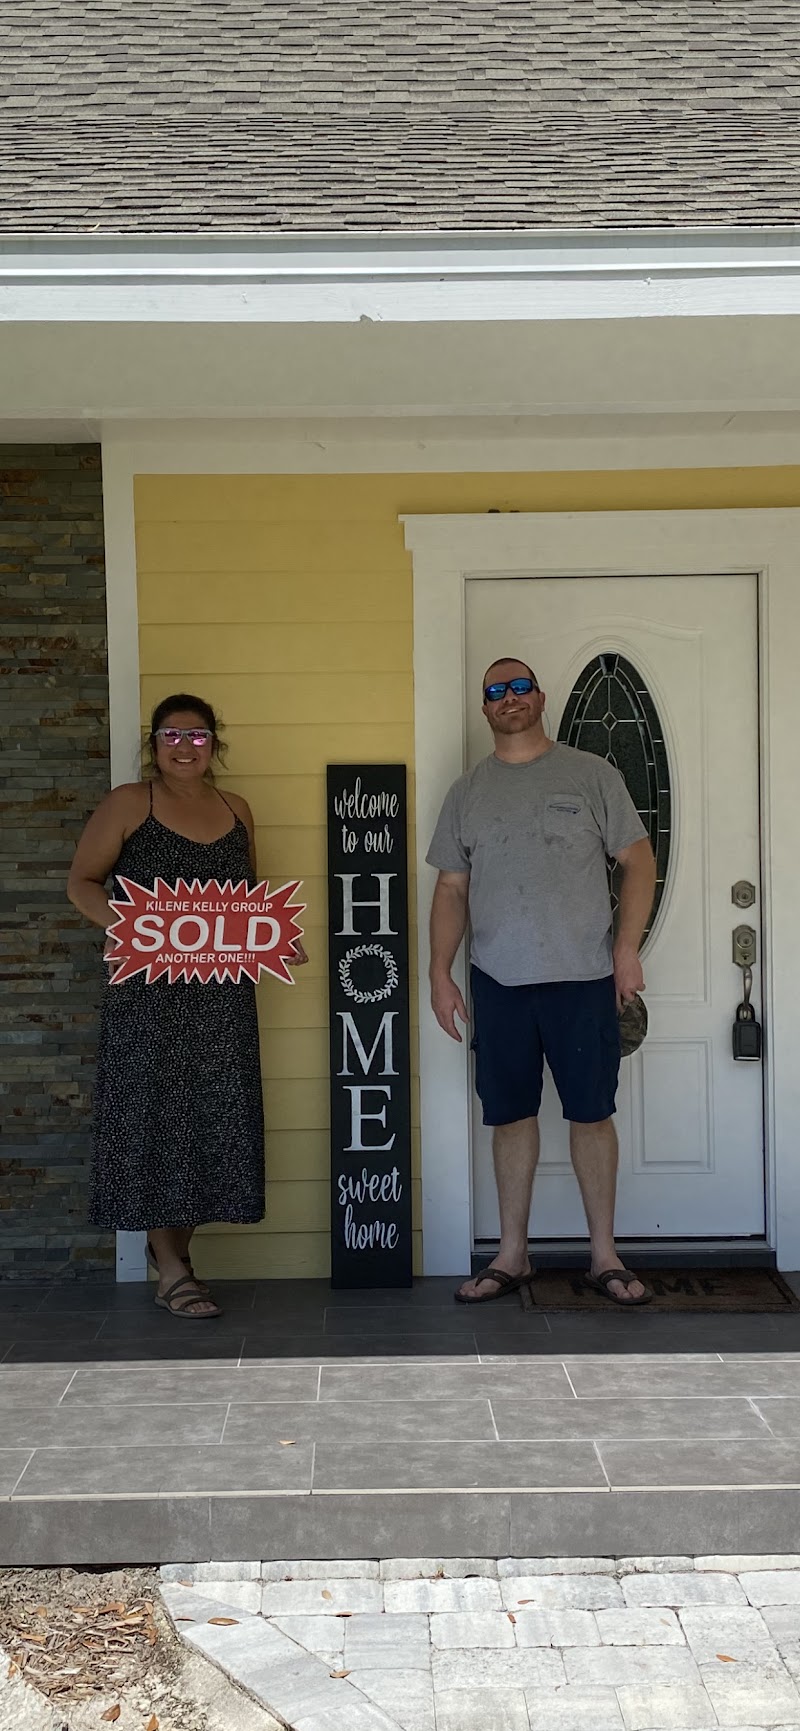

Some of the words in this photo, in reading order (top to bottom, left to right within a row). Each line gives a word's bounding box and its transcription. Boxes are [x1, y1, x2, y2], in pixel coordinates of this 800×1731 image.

[334, 776, 399, 819] welcome
[341, 823, 359, 854] to
[364, 823, 395, 853] our
[146, 900, 189, 912] KILENE
[192, 901, 228, 912] KELLY
[231, 903, 273, 913] GROUP
[131, 914, 281, 952] SOLD
[155, 952, 215, 964] ANOTHER
[218, 953, 256, 963] ONE!!!
[338, 1166, 402, 1206] sweet
[344, 1204, 399, 1249] home
